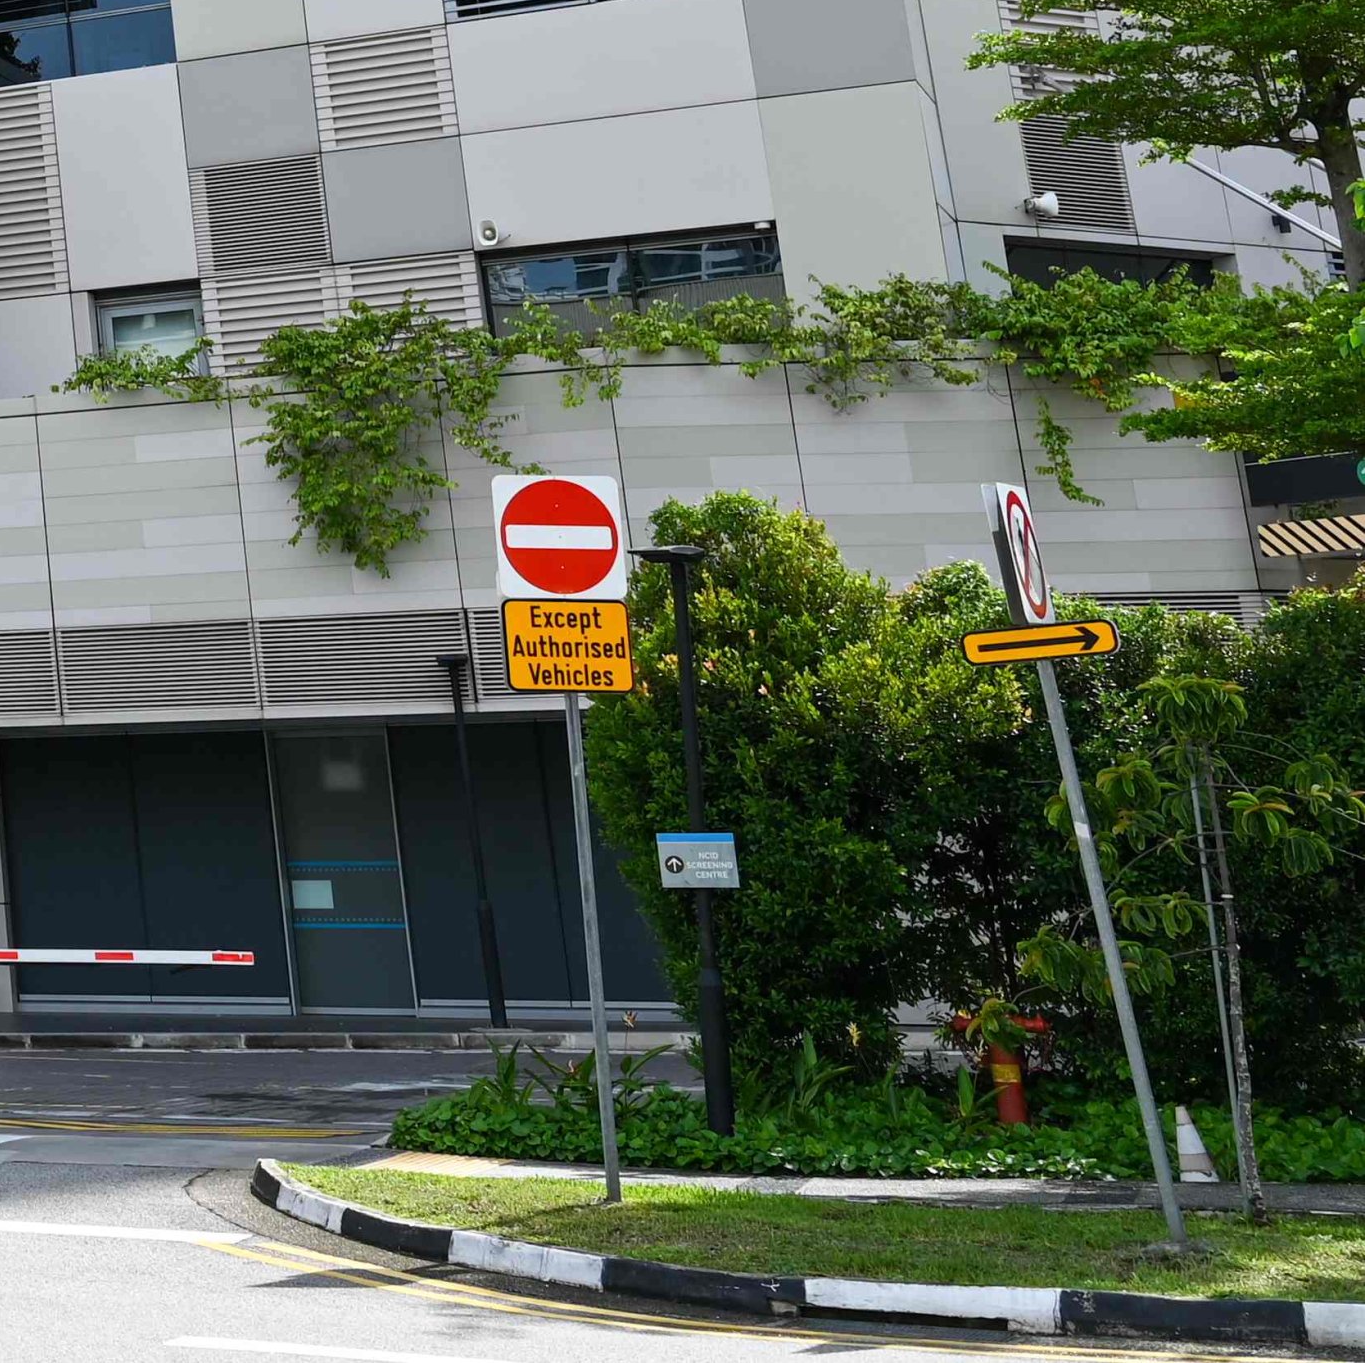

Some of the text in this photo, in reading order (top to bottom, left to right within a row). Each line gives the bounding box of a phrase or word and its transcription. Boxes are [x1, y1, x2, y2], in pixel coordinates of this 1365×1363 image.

[530, 605, 602, 635] Except
[513, 634, 626, 659] Authorised
[528, 663, 614, 687] Vehicles
[695, 870, 729, 879] CENTRE
